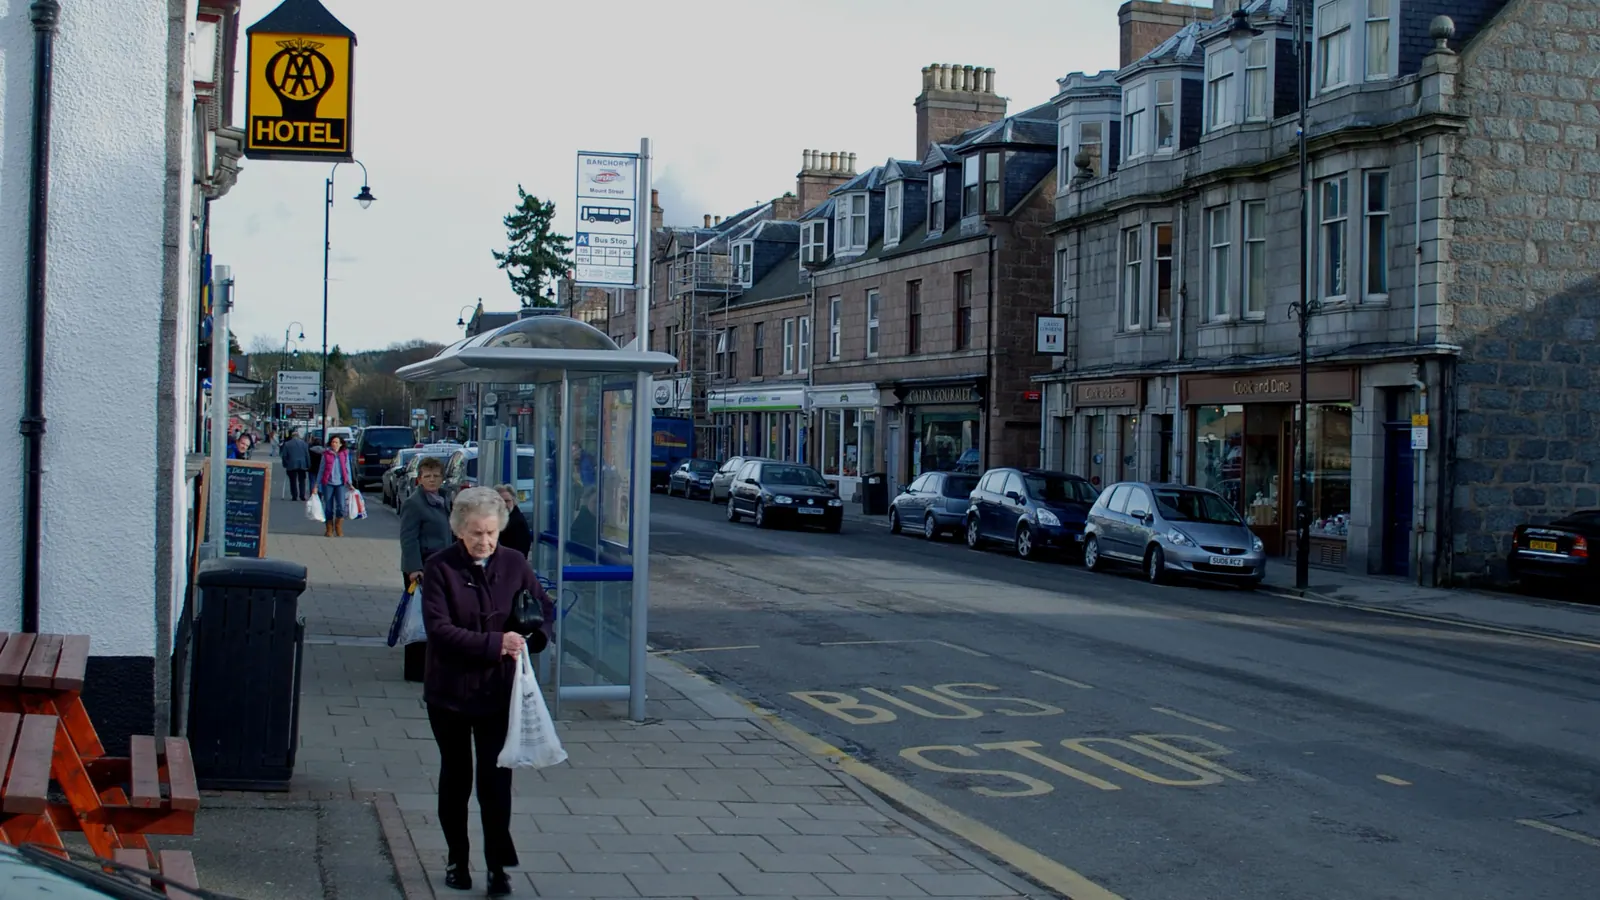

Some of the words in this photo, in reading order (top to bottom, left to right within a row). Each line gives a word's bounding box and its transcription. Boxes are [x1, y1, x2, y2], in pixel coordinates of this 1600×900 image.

[279, 52, 321, 96] AA
[256, 120, 340, 144] HOTEL
[586, 159, 629, 167] BANCHORY
[577, 235, 587, 244] A
[609, 237, 628, 245] Stop
[908, 388, 932, 402] CAIRN
[933, 387, 972, 401] GOURMET
[1233, 380, 1254, 395] Cook
[1255, 379, 1270, 393] and
[1271, 378, 1291, 393] Dine
[788, 682, 1064, 726] BUS
[899, 733, 1257, 798] STOP
